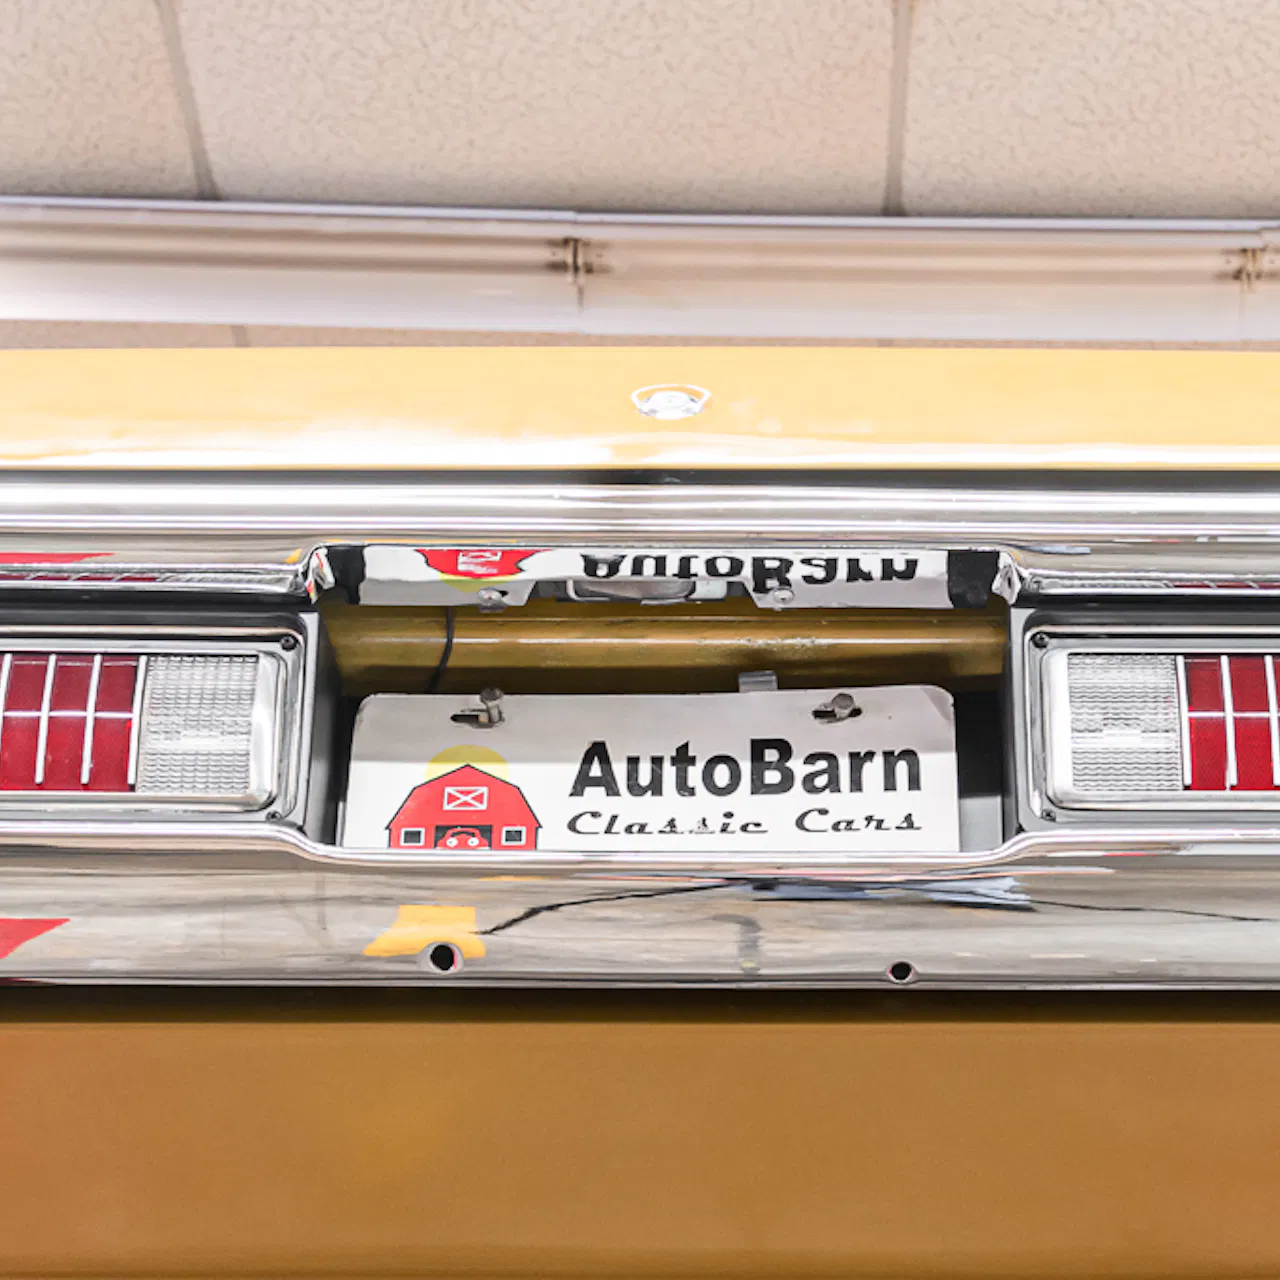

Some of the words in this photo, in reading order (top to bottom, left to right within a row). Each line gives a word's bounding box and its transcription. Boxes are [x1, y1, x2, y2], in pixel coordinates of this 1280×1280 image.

[569, 738, 922, 797] AutoBarn
[567, 811, 768, 834] Classic
[795, 808, 923, 832] Cars
